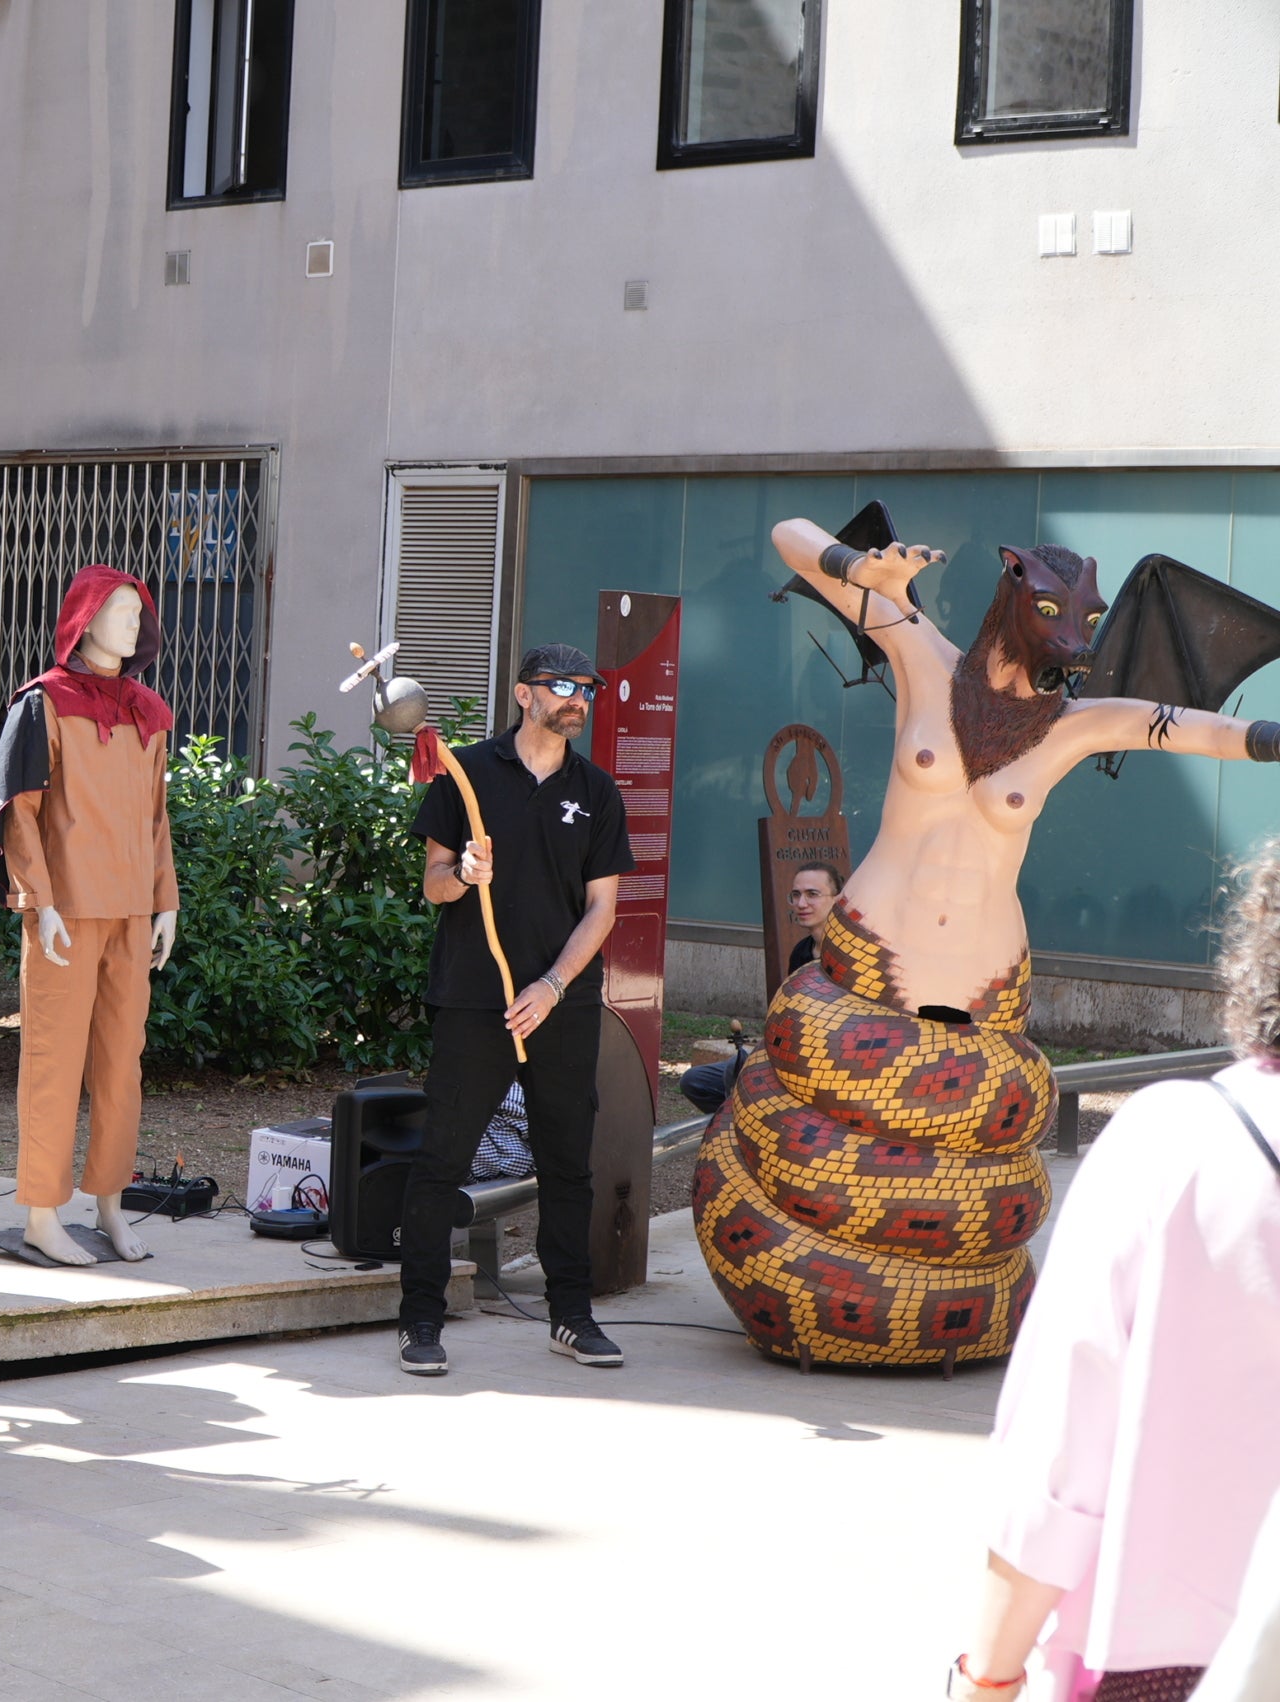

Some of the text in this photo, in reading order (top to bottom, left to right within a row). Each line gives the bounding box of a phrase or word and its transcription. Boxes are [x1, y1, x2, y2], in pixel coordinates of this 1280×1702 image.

[639, 702, 645, 711] La
[645, 702, 655, 711] Torre
[787, 828, 830, 842] CIUTAT
[271, 1153, 311, 1172] YAMAHA
